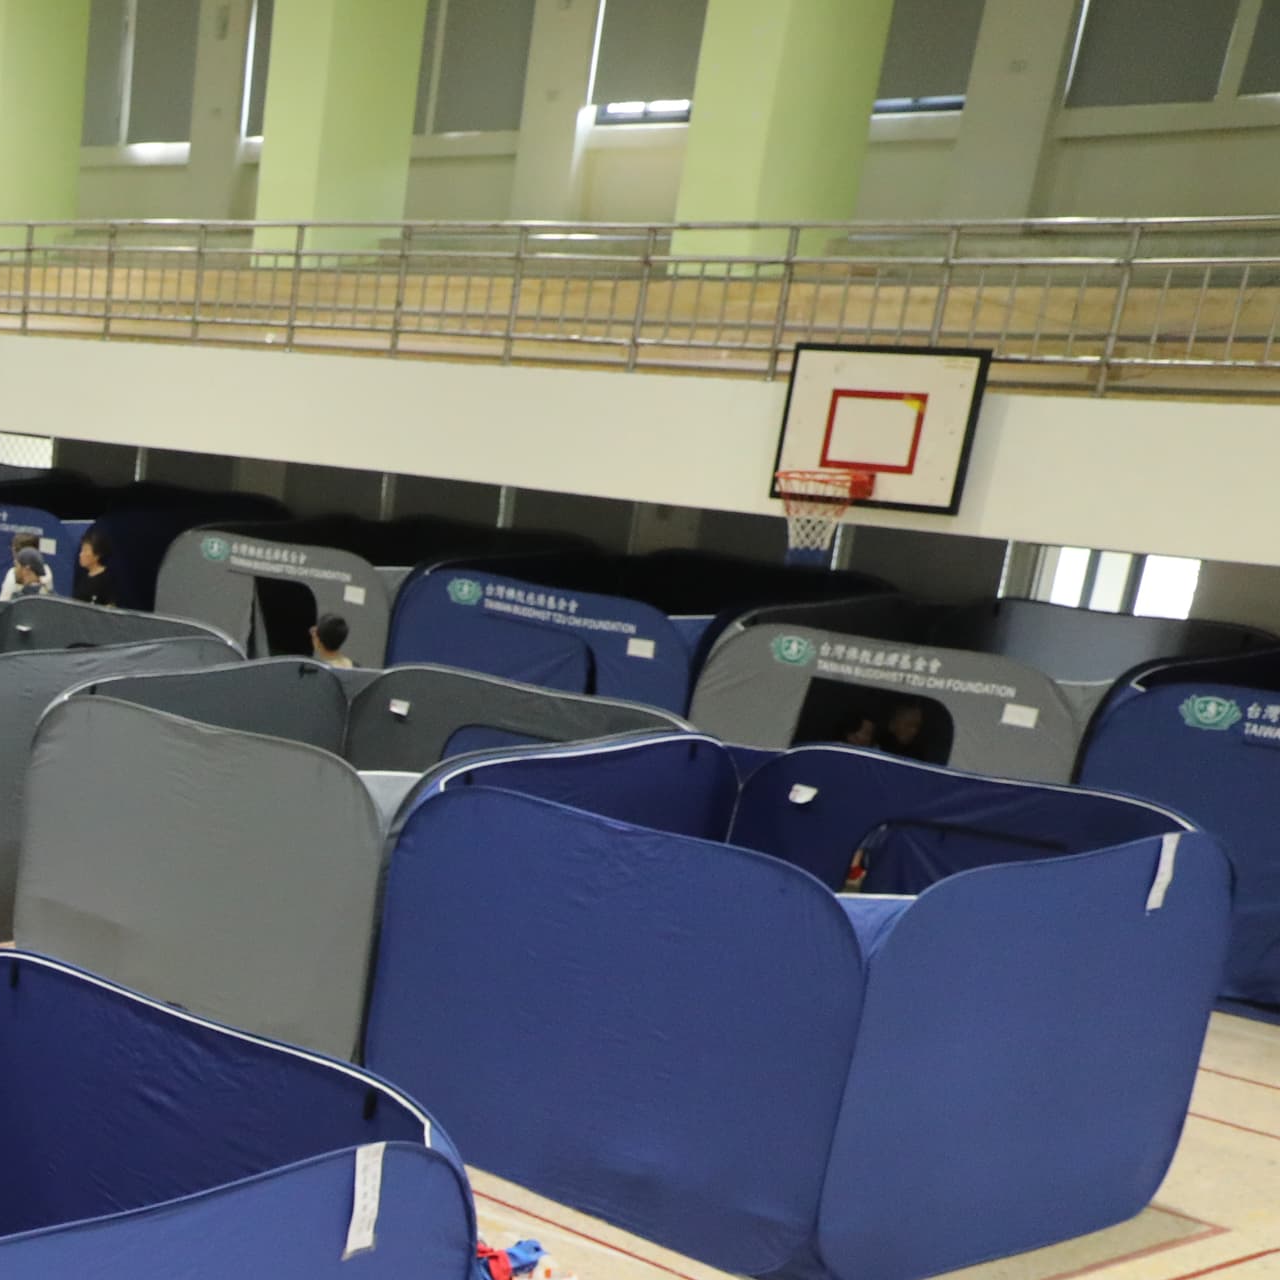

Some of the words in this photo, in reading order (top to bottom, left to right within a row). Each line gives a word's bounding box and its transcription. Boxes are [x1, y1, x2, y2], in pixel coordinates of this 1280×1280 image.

[817, 659, 852, 676] TAIWAN
[906, 672, 925, 688] TZU
[926, 675, 944, 690] CHI
[946, 678, 1016, 699] FOUNDATION
